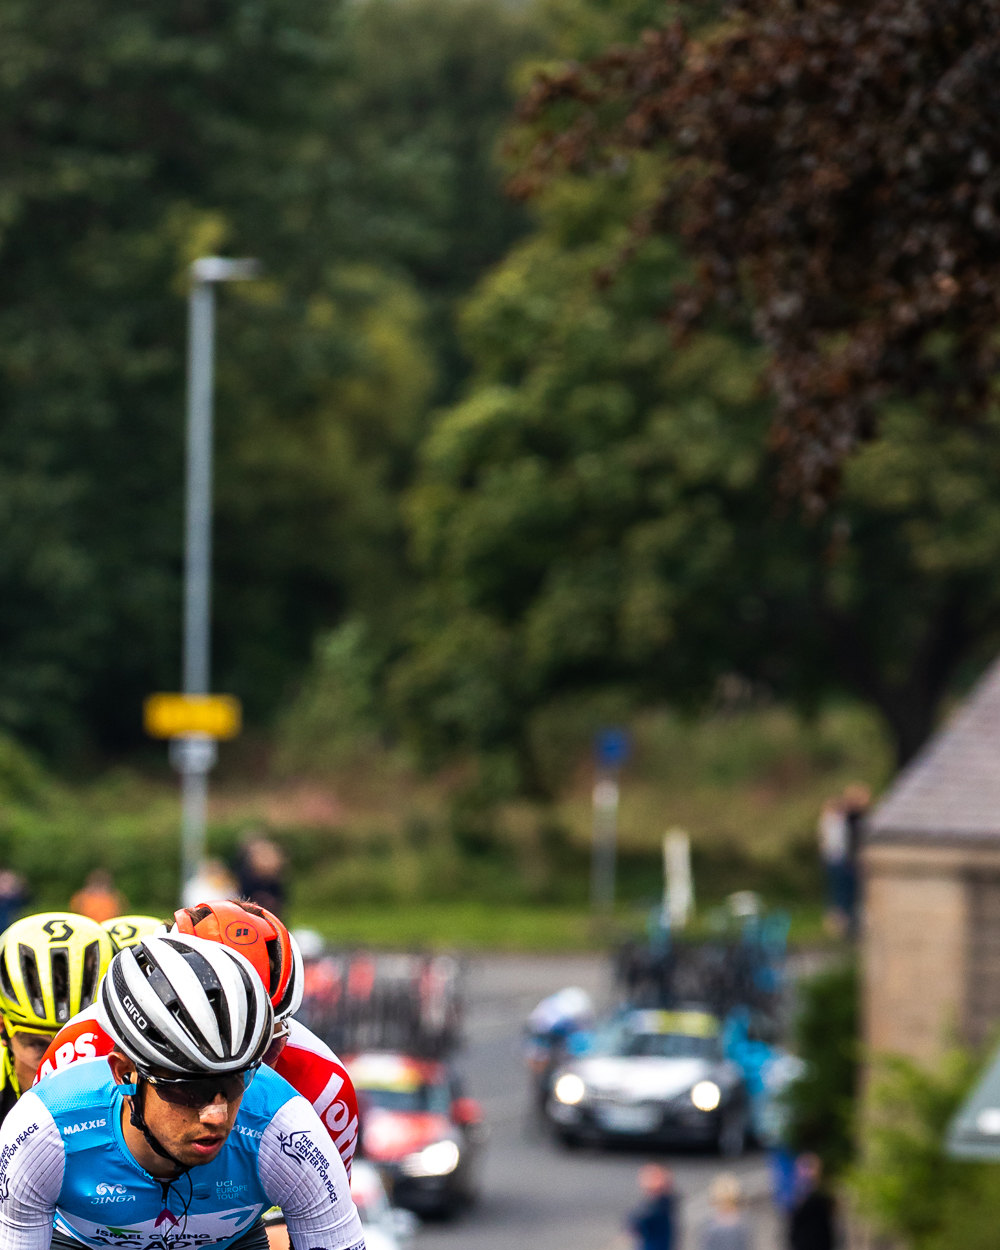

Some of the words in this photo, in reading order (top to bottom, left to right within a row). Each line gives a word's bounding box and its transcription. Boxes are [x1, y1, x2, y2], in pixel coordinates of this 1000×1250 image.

[122, 995, 148, 1031] GIRO
[63, 1118, 107, 1136] MAXXIS
[232, 1124, 263, 1140] AXXIS
[6, 1142, 19, 1161] FOR
[15, 1122, 40, 1147] PEACE
[299, 1133, 314, 1149] THE
[312, 1146, 330, 1171] PERES
[294, 1140, 321, 1169] CENTER
[316, 1165, 328, 1183] FOR
[215, 1179, 233, 1187] UCI
[215, 1184, 249, 1194] EUROPE
[90, 1194, 136, 1205] JINGA
[95, 1228, 145, 1240] ISRAEL
[148, 1232, 211, 1241] CYCLING
